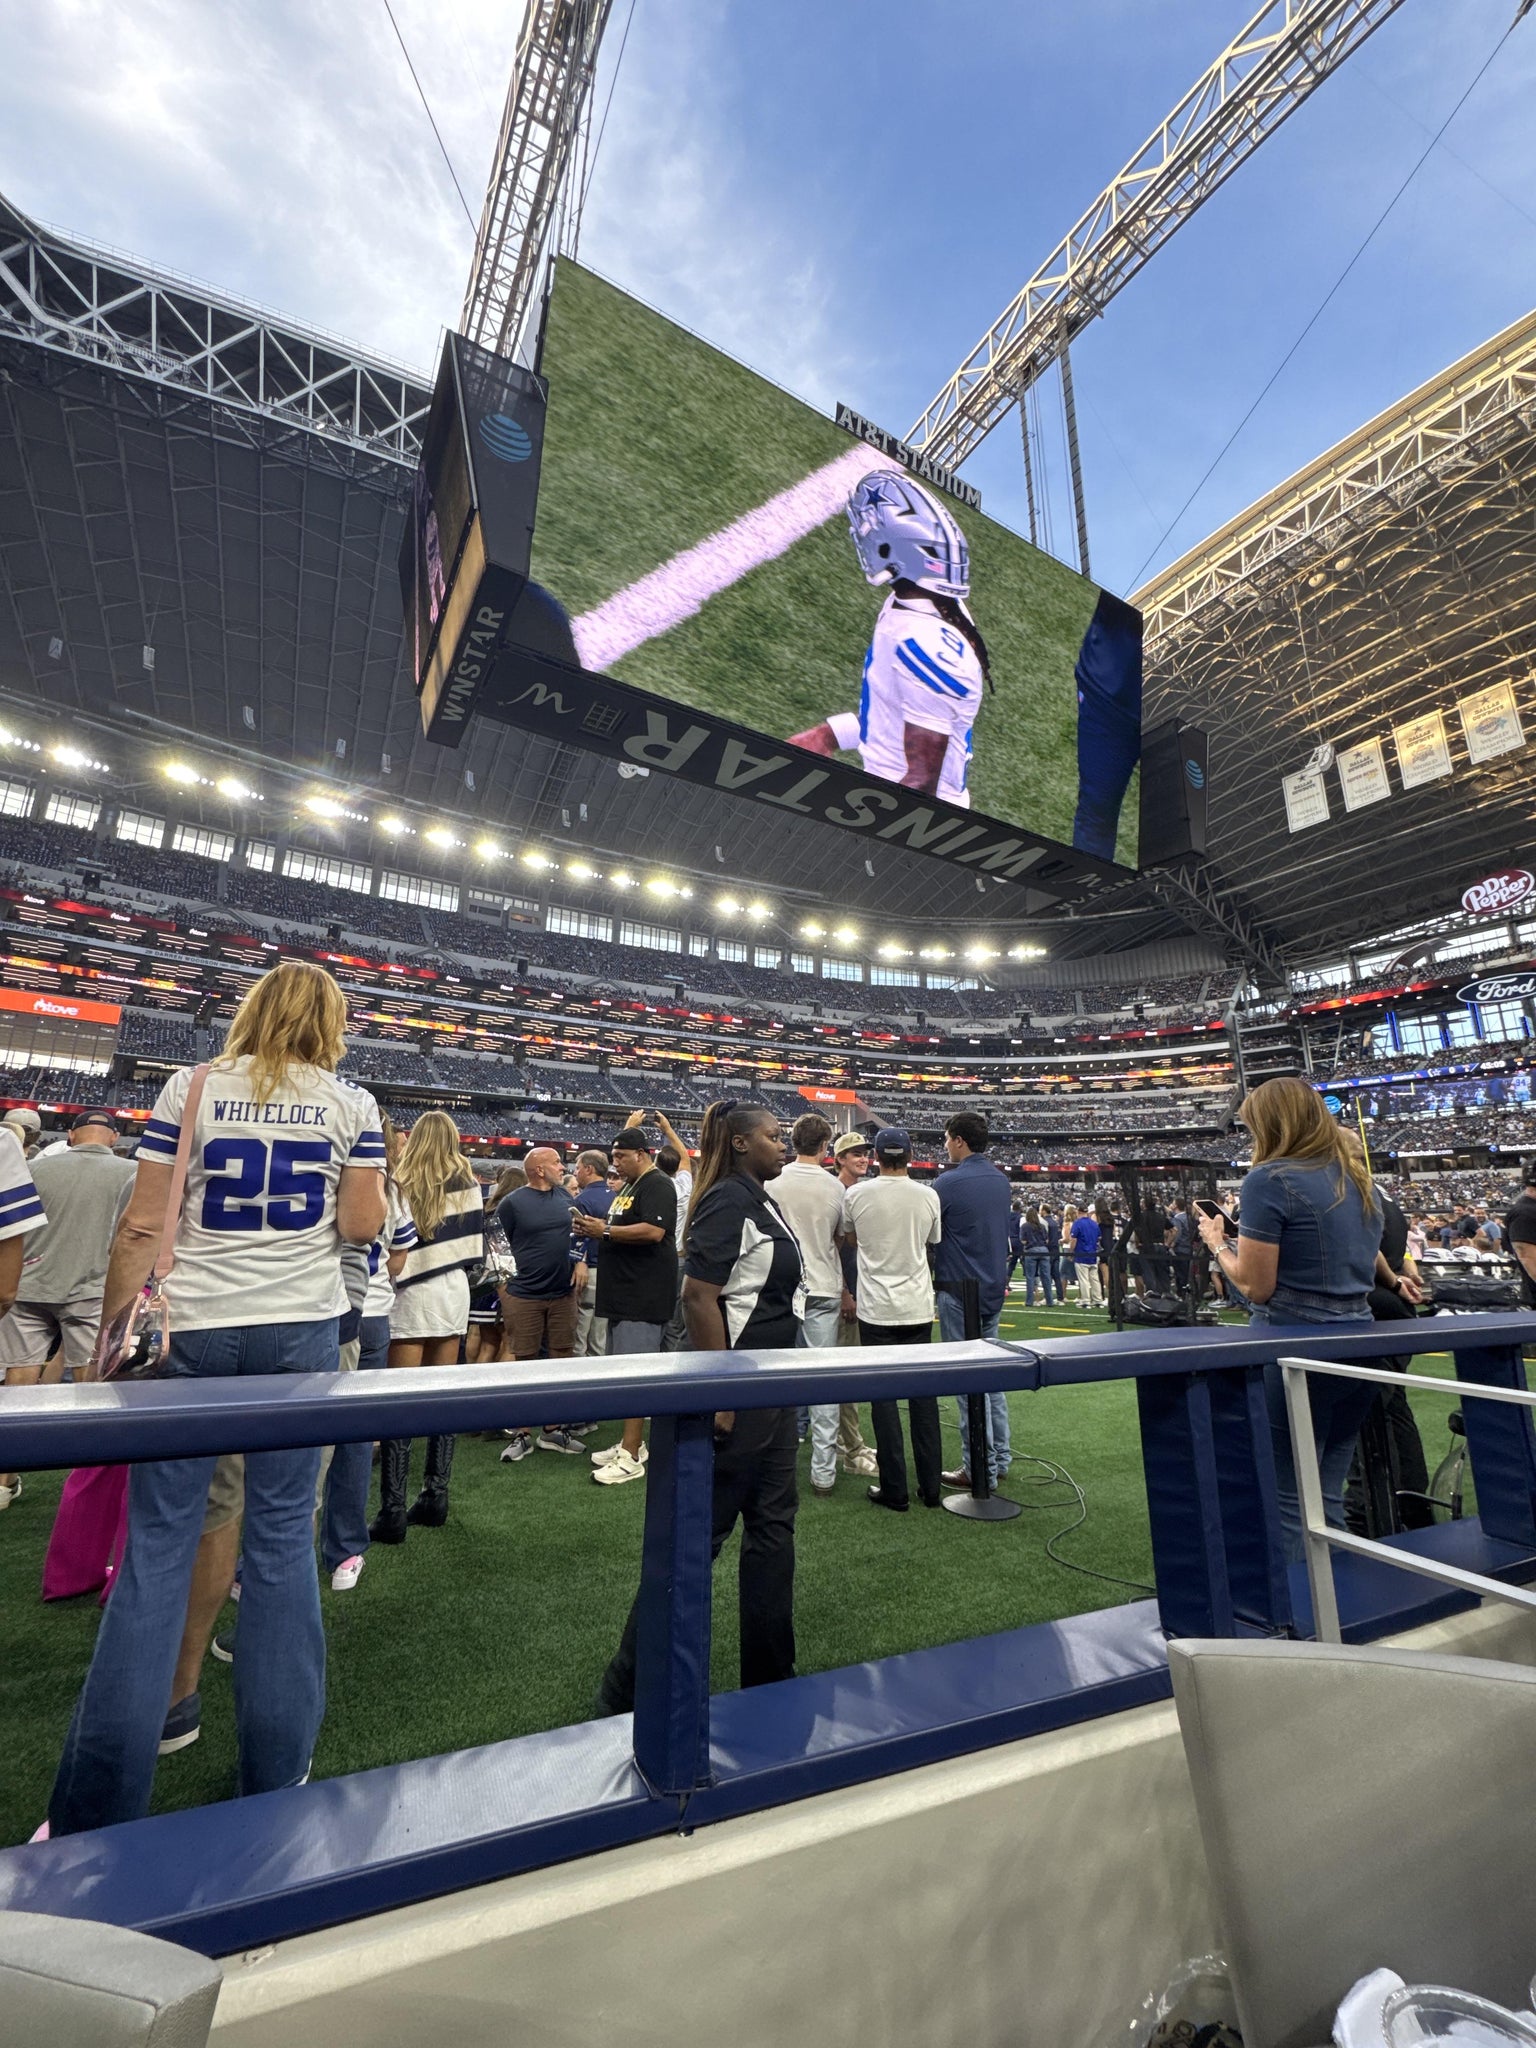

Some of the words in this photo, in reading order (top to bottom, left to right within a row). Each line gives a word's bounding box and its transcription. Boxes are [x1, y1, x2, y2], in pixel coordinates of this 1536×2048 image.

[837, 405, 892, 454] AT&T
[895, 442, 982, 511] STADIUM
[441, 606, 504, 721] WINSTAR
[623, 710, 1048, 878] WINSTAR
[1468, 876, 1529, 912] Pepper
[1482, 875, 1510, 895] Dr
[1476, 977, 1536, 1001] Ford
[213, 1100, 328, 1126] WHITELOCK
[1397, 1149, 1454, 1158] Blockchain.com
[202, 1138, 332, 1231] 25
